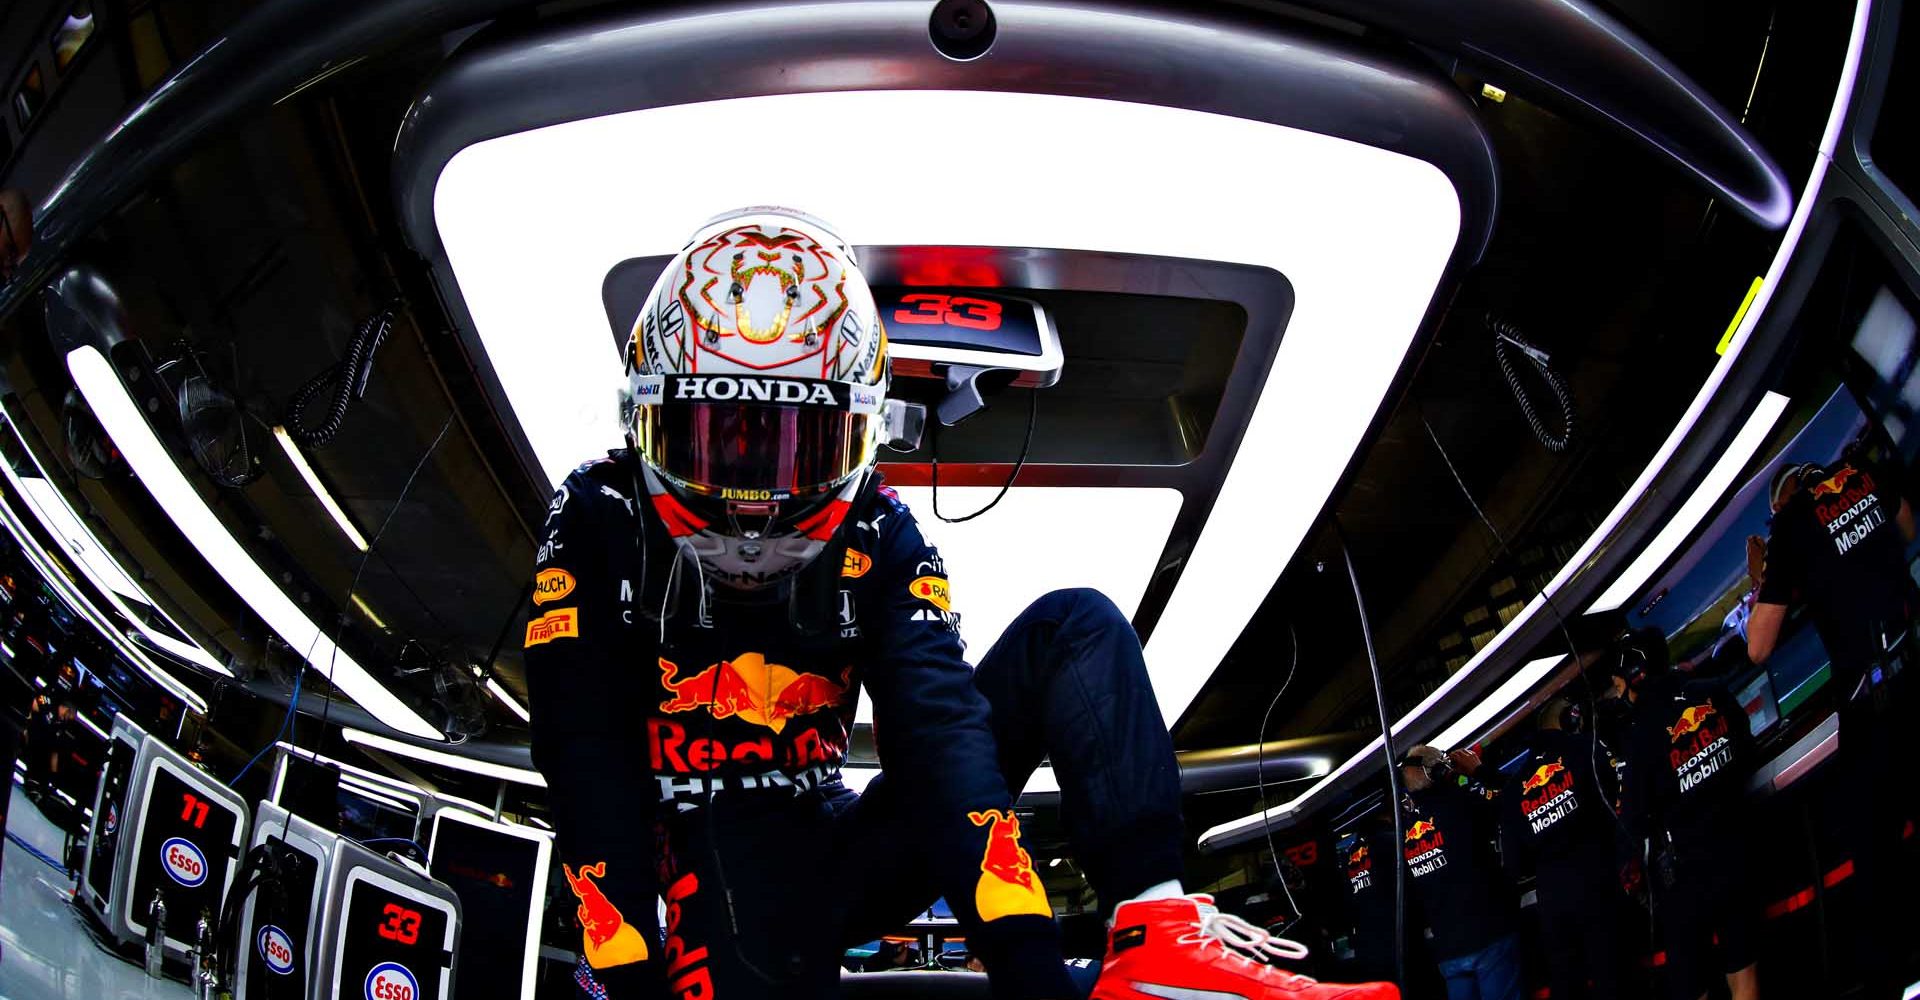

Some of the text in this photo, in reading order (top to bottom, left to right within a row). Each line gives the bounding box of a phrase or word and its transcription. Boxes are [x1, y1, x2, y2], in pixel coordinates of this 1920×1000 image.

[894, 293, 1002, 331] 33
[674, 377, 838, 406] HONDA
[719, 488, 790, 501] JUMBO.com
[1816, 496, 1850, 527] Red
[1827, 493, 1879, 534] HONDA
[1835, 514, 1875, 556] Mobil
[535, 577, 566, 593] AUCH
[1676, 736, 1729, 777] HONDA
[1680, 756, 1720, 793] Mobil
[1521, 770, 1574, 816] Red Bull
[1527, 789, 1574, 821] HONDA
[181, 793, 210, 829] 11
[1531, 805, 1565, 835] Mobil
[1407, 847, 1443, 866] HONDA
[1411, 860, 1435, 878] Mobil
[378, 903, 422, 946] 33
